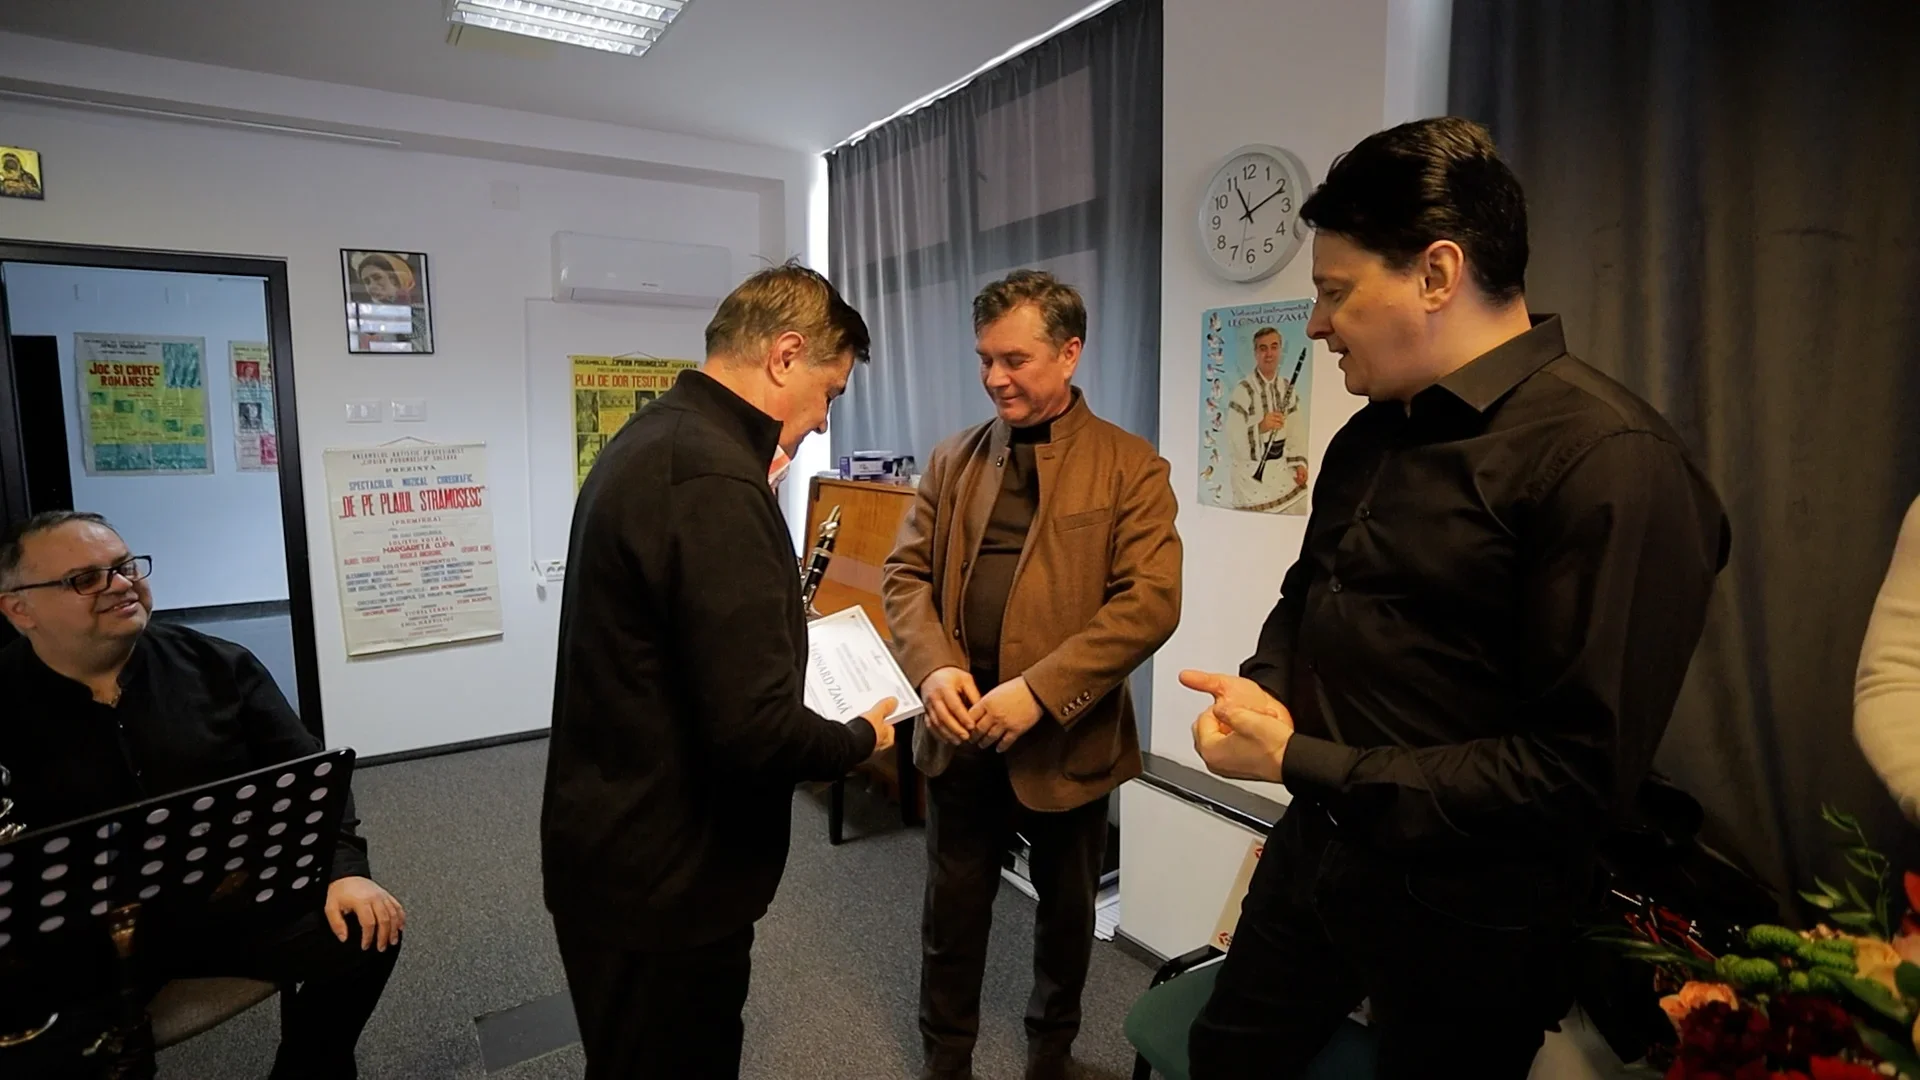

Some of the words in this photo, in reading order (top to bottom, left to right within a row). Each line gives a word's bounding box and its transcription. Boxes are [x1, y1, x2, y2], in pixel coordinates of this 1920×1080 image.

[1242, 163, 1257, 180] 12
[1265, 165, 1271, 181] 1
[1227, 176, 1238, 192] 11
[1276, 178, 1286, 194] 2
[1215, 194, 1228, 211] 10
[1281, 197, 1291, 213] 3
[1212, 215, 1221, 230] 9
[1275, 220, 1286, 235] 4
[1217, 235, 1226, 250] 8
[1263, 237, 1273, 253] 5
[1230, 245, 1239, 260] 7
[1246, 248, 1256, 263] 6
[1228, 315, 1274, 327] LEONARD
[89, 362, 110, 375] JOC
[575, 374, 595, 387] PLAI
[599, 374, 610, 387] DE
[612, 375, 629, 388] DOR
[362, 493, 375, 517] PE
[379, 491, 415, 515] PLAIUL
[383, 542, 430, 554] MARGARETA
